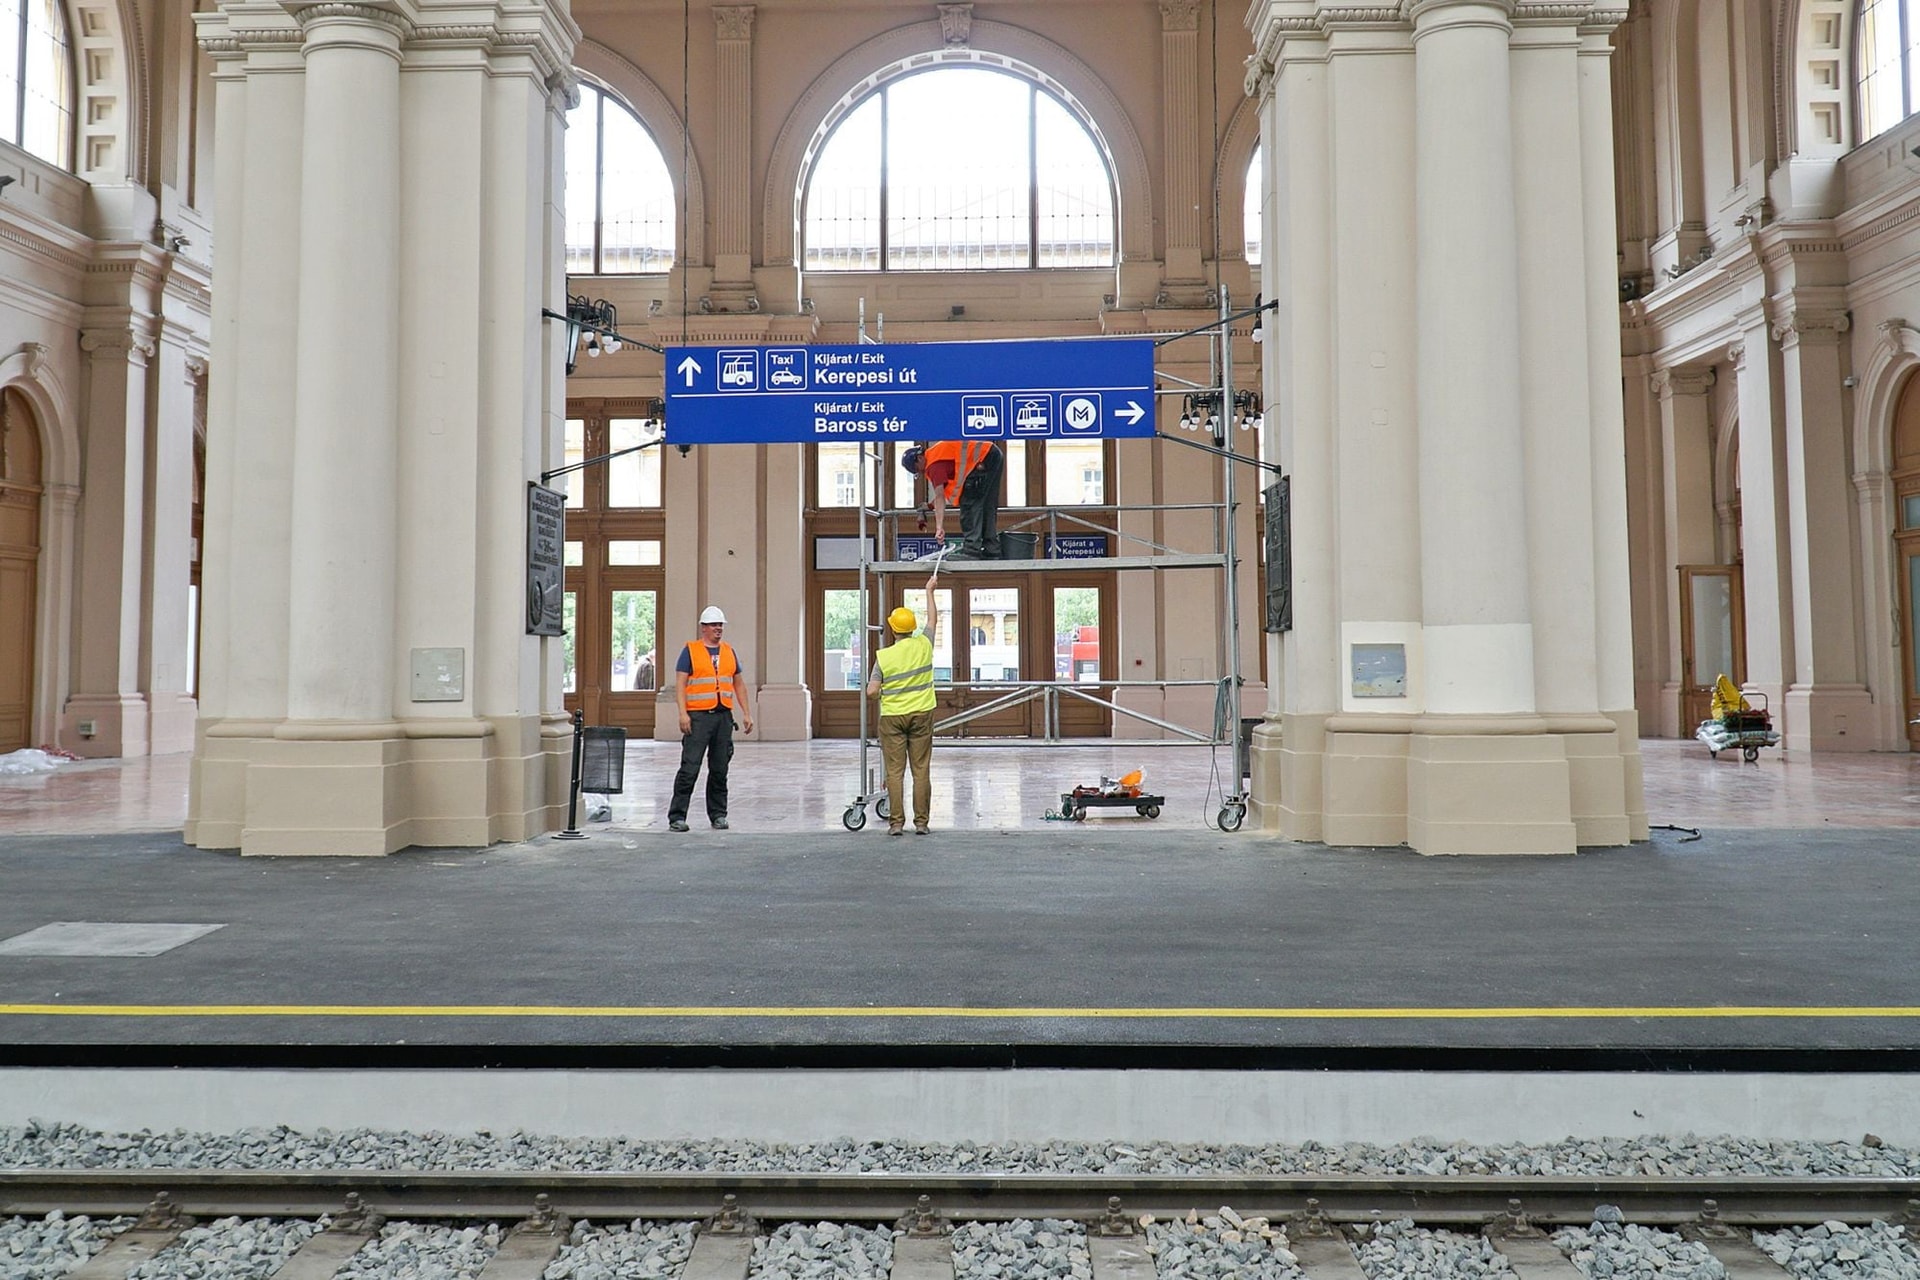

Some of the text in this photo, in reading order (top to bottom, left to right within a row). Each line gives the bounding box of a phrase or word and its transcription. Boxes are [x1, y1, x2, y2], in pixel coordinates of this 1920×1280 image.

[771, 354, 793, 365] Taxi
[815, 353, 885, 366] Kijárat / Exit
[815, 368, 917, 387] Kerepesi út
[815, 401, 885, 415] Kijárat / Exit
[815, 416, 908, 433] Baross tér
[1062, 540, 1086, 548] Kijárat
[1062, 547, 1104, 556] Kerepesi út
